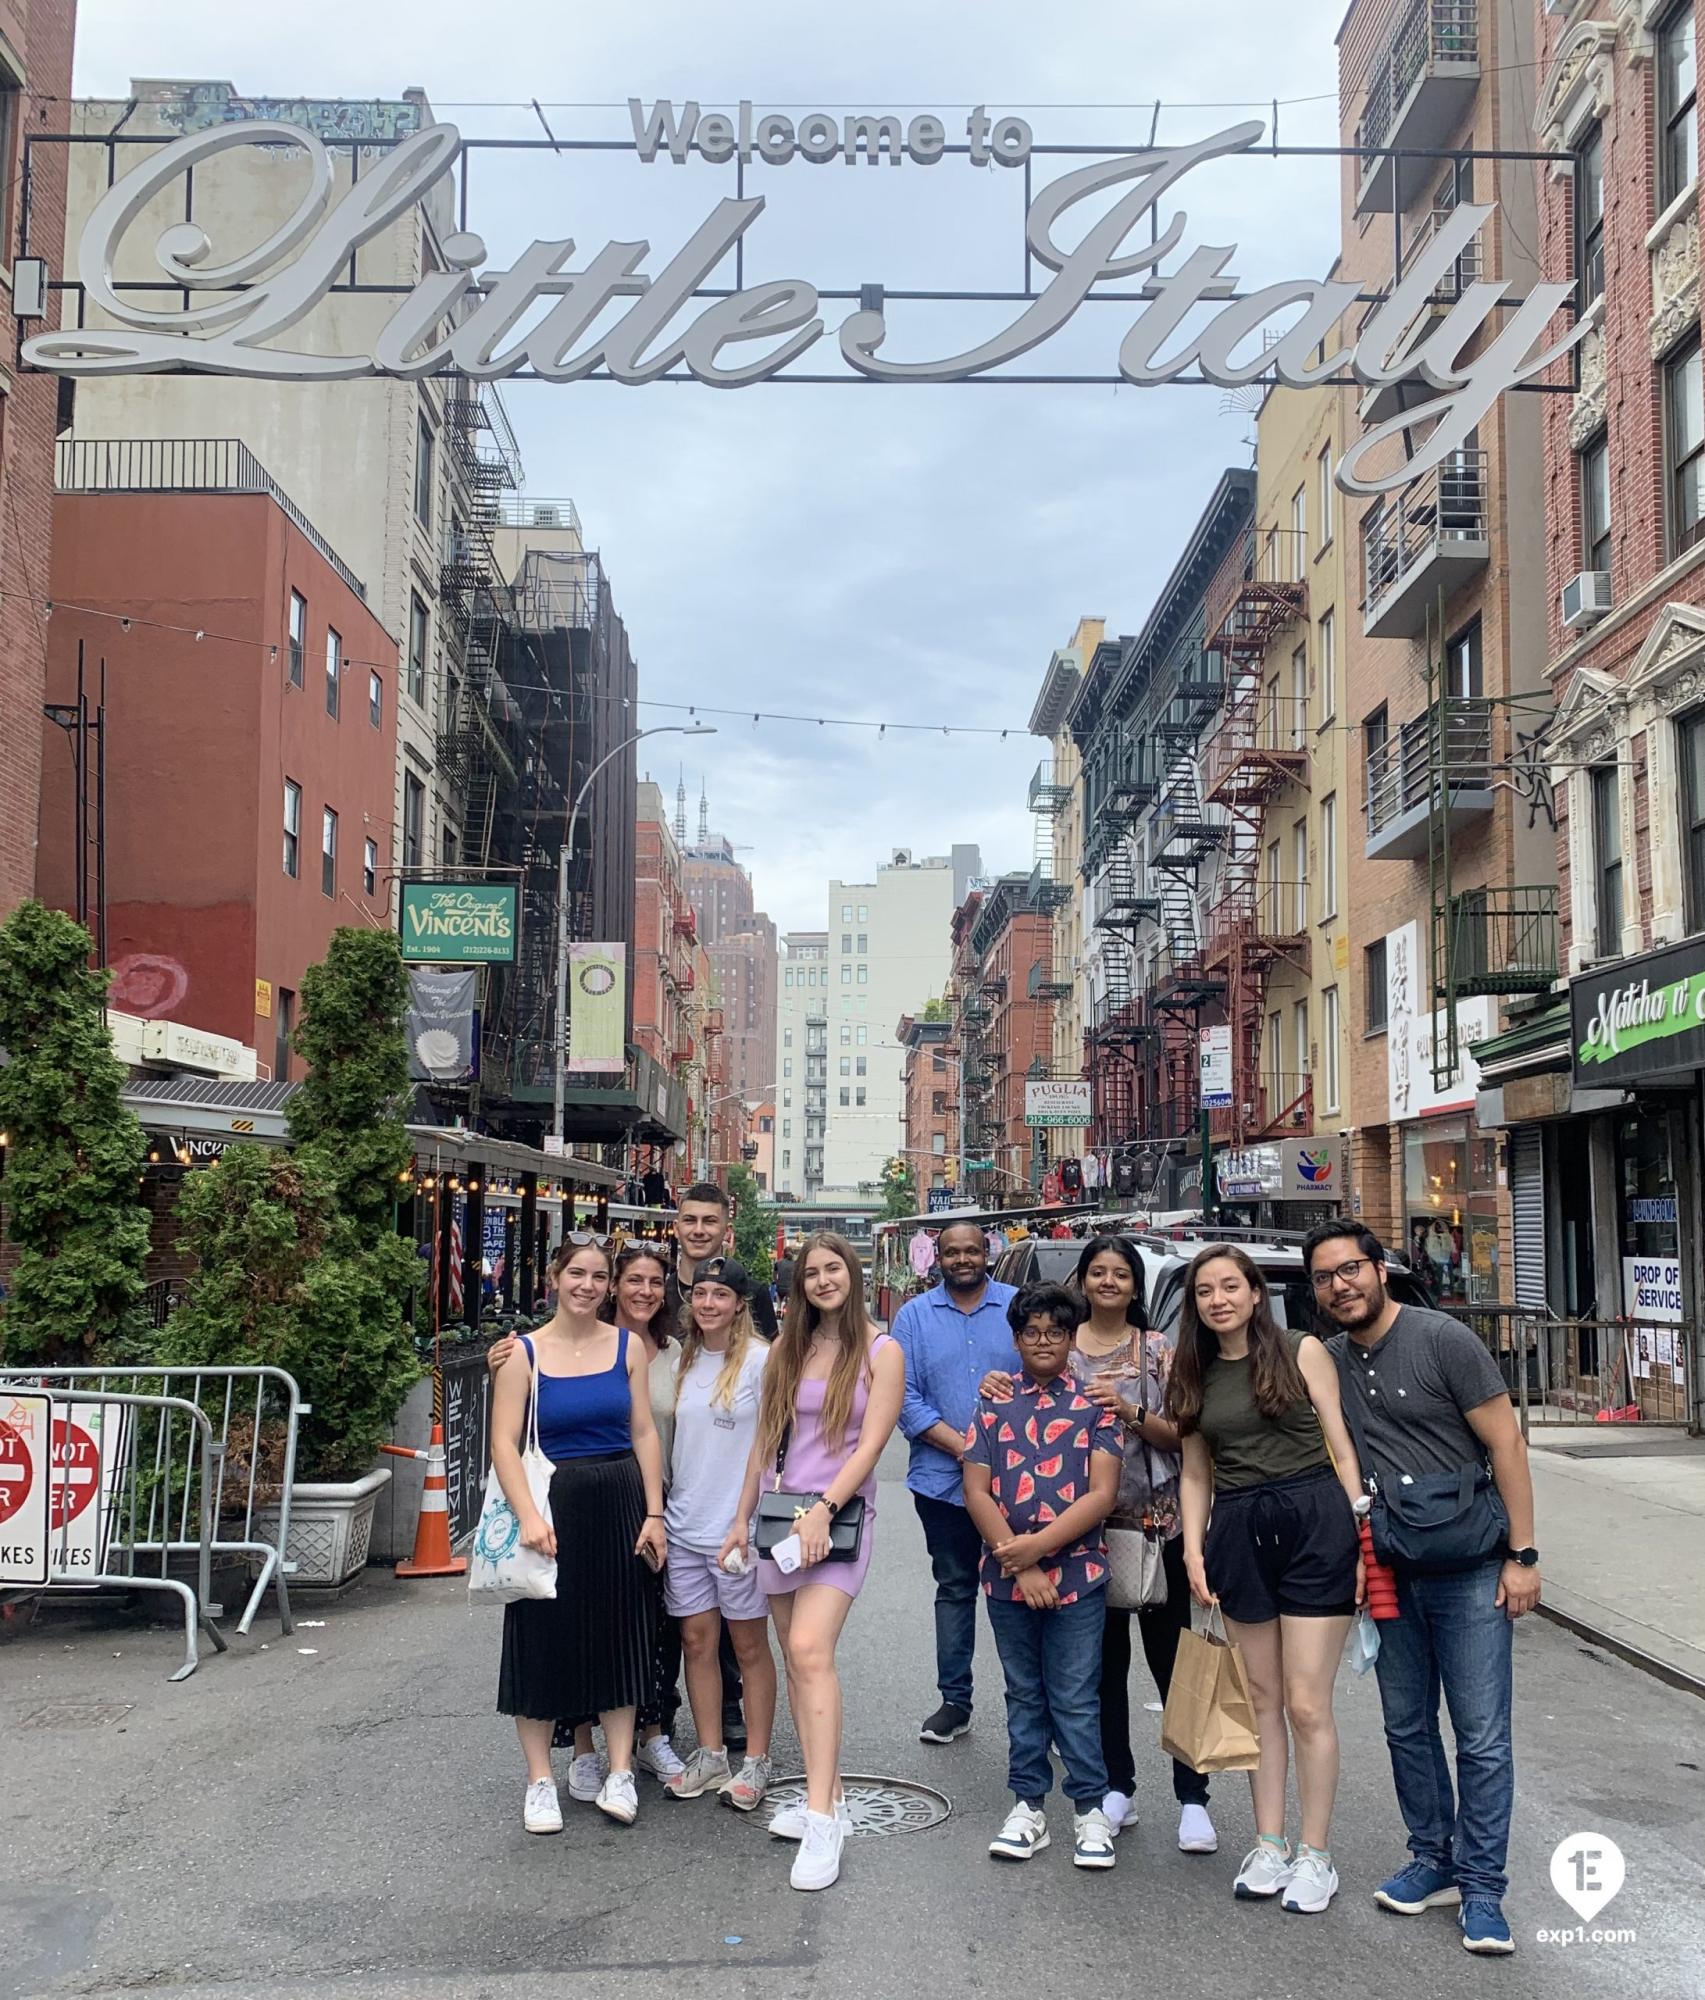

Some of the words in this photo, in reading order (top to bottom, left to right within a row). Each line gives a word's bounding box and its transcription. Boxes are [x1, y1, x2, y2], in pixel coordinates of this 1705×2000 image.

[628, 98, 945, 166] Welcome
[967, 105, 1033, 168] to
[20, 119, 825, 389] Little
[839, 119, 1595, 496] Italy
[430, 892, 456, 909] The
[457, 892, 507, 916] Original
[406, 945, 421, 953] Est.
[416, 983, 451, 994] Welcome
[431, 996, 446, 1007] The
[1588, 979, 1667, 1054] Matcha
[1032, 1083, 1088, 1098] PUGLIA
[1028, 1115, 1091, 1125] 212-966-6006
[1634, 1265, 1661, 1284] DROP
[1638, 1288, 1682, 1310] SERVICE
